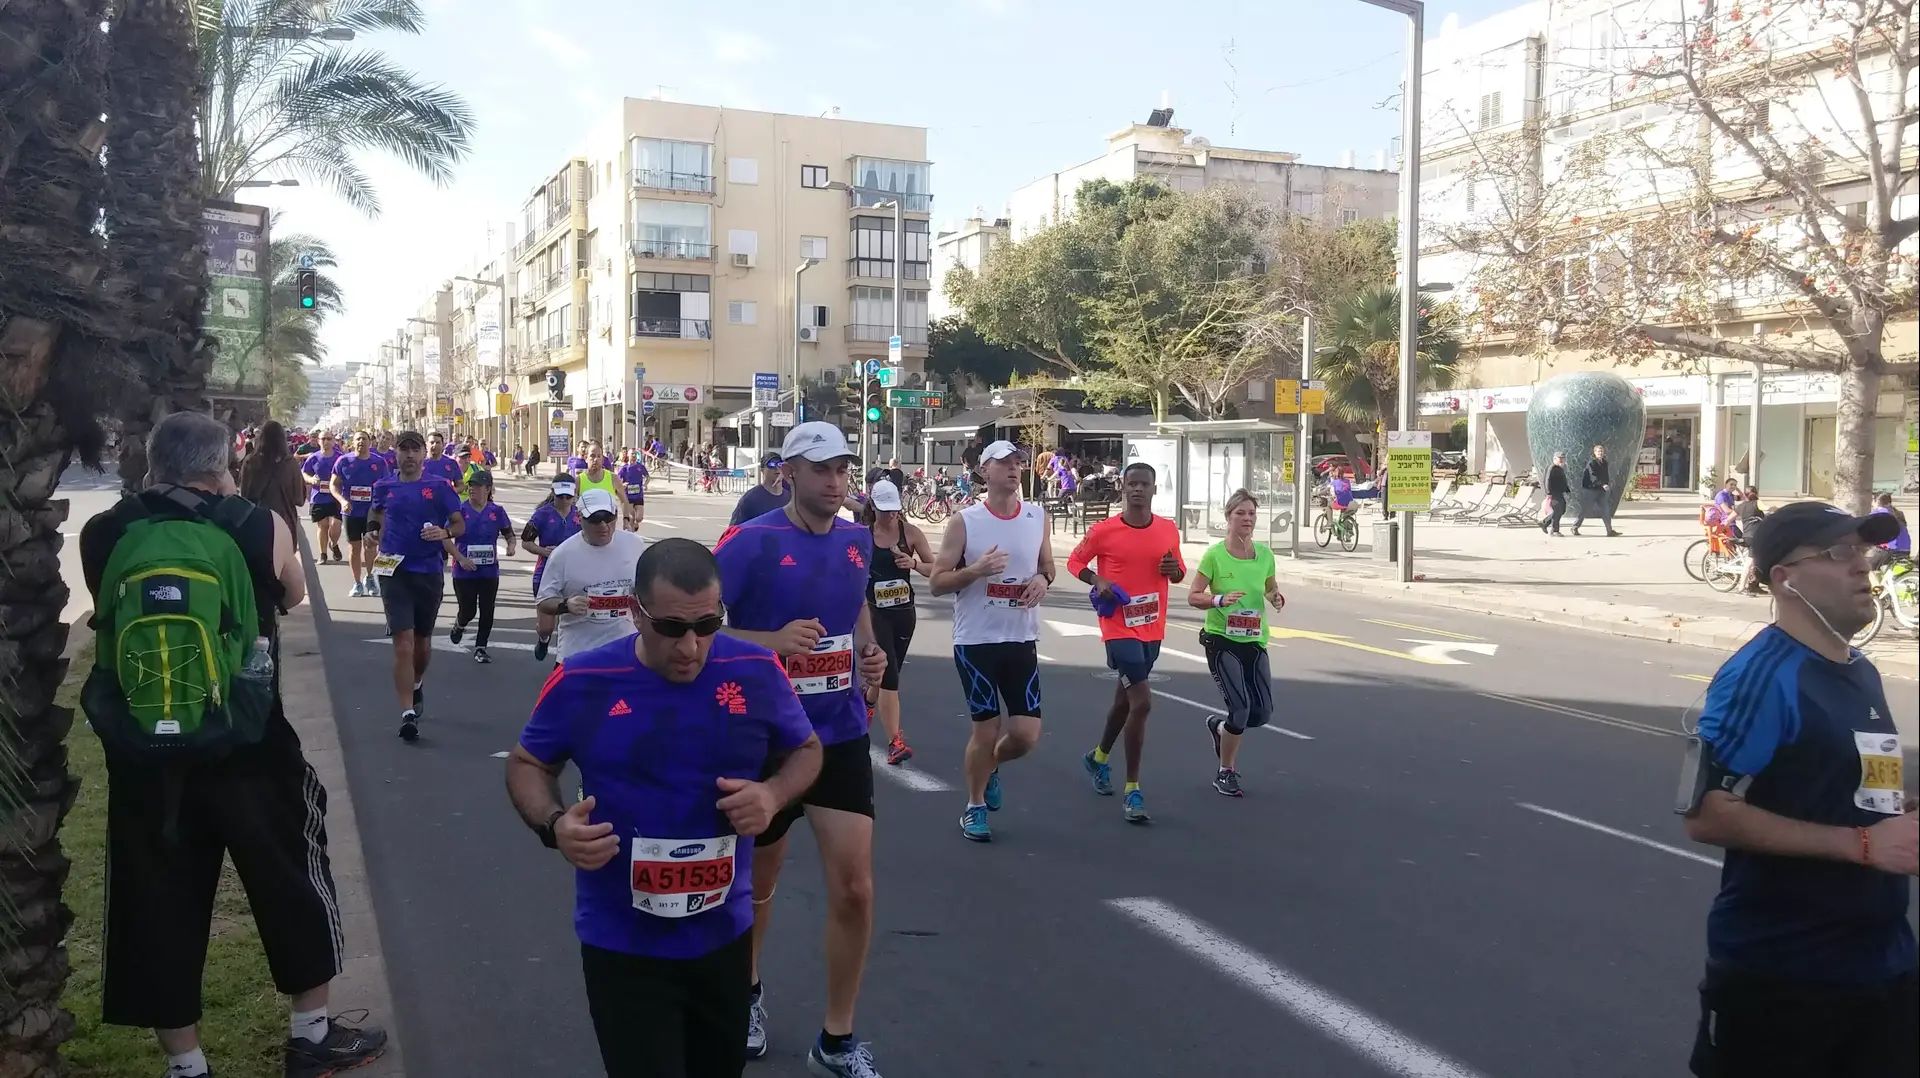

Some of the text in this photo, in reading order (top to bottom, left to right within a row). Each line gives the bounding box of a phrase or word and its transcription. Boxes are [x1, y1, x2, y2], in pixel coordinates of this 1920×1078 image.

[240, 231, 252, 241] 20
[1413, 454, 1430, 462] מרתון
[877, 587, 909, 598] A60970
[673, 847, 702, 855] SAMSUNG
